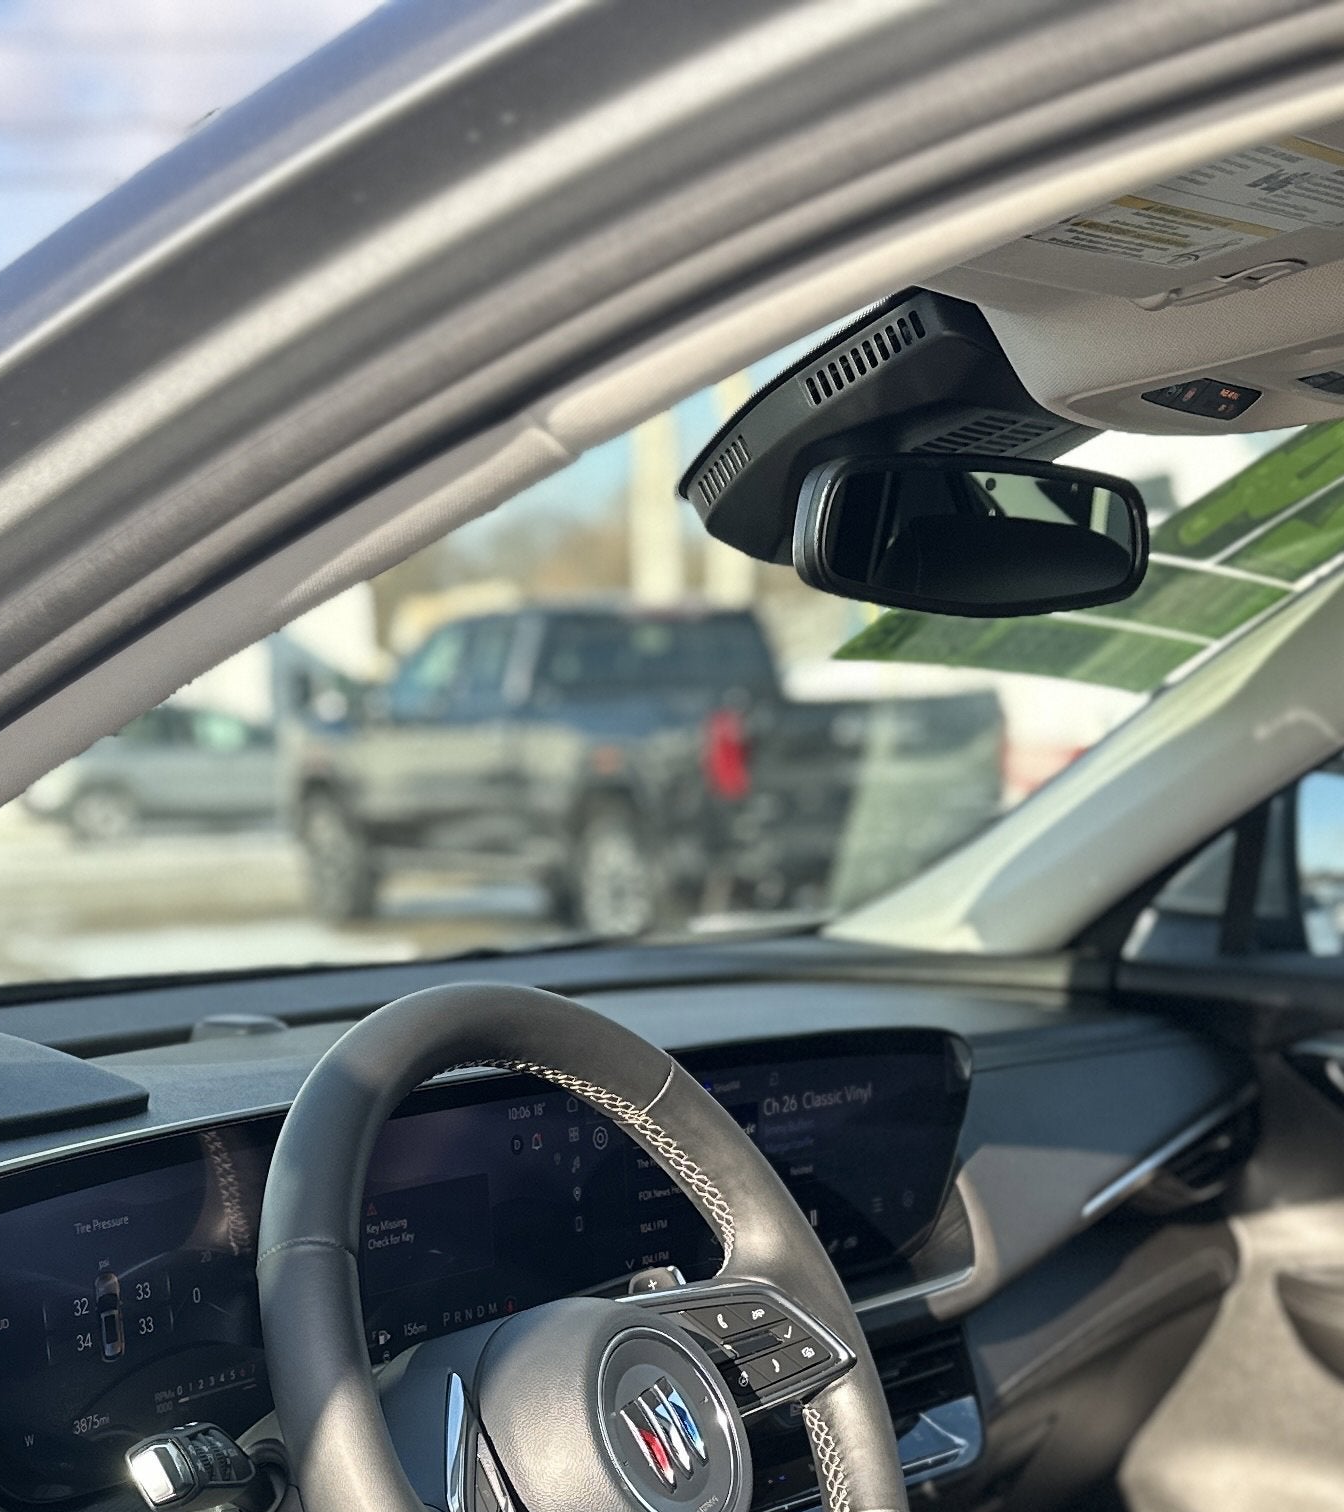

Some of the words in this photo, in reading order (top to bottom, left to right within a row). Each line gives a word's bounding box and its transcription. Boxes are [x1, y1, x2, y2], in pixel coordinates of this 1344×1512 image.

[763, 1097, 779, 1116] Ch
[782, 1095, 798, 1113] 26
[802, 1090, 842, 1109] Classic
[844, 1082, 873, 1105] Vinyl
[508, 1106, 531, 1121] 10:06
[73, 1222, 92, 1235] Tire
[92, 1215, 129, 1231] Pressure
[366, 1224, 380, 1235] Key
[380, 1218, 408, 1231] Missing
[368, 1236, 389, 1250] Check
[390, 1234, 401, 1245] for
[401, 1231, 416, 1244] Key
[135, 1281, 151, 1300] 33
[192, 1287, 201, 1304] 0
[73, 1297, 89, 1317] 32
[138, 1316, 154, 1335] 33
[76, 1332, 93, 1352] 34
